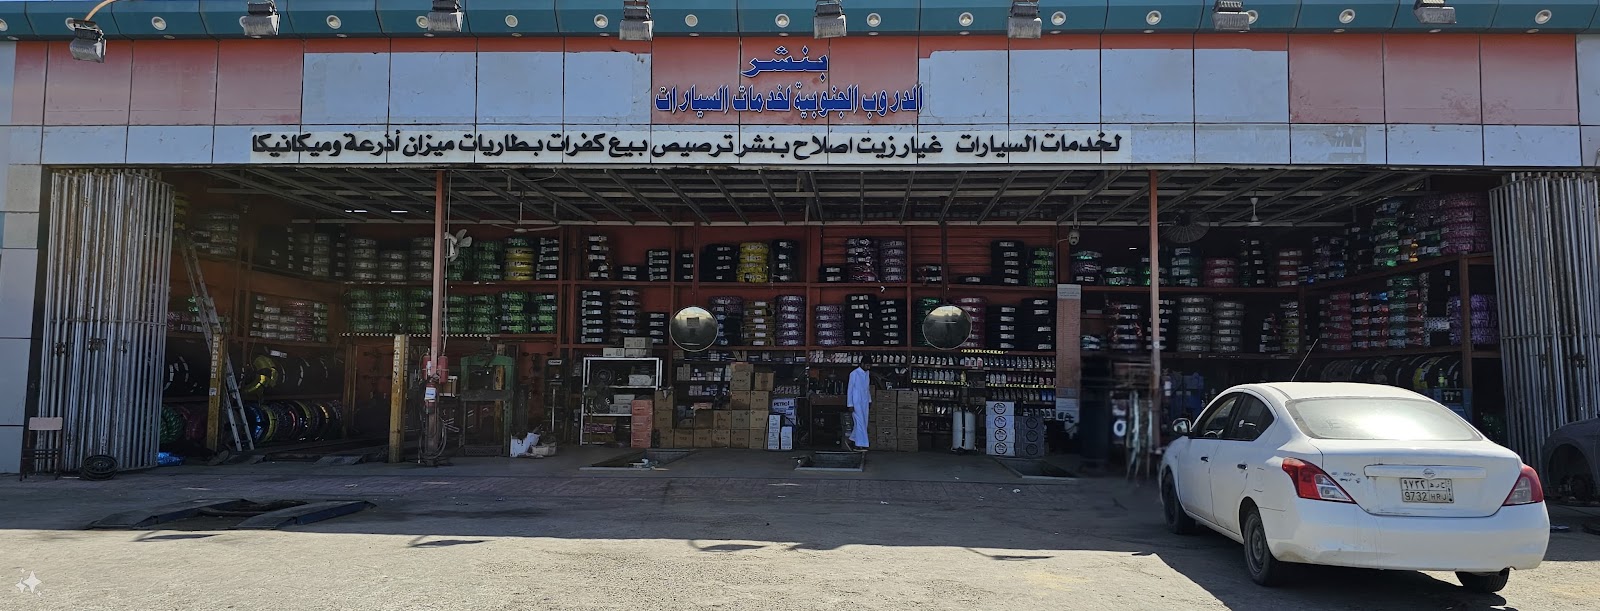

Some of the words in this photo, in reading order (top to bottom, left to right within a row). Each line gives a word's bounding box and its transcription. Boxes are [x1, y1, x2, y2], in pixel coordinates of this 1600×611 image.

[741, 45, 829, 83] بنشر
[654, 84, 730, 118] السيارات
[732, 84, 791, 113] لخدمات
[793, 82, 859, 119] الجنوبية
[861, 83, 924, 120] الدروب
[252, 133, 342, 158] وميكانيكا
[343, 129, 401, 156] أذرعة
[402, 134, 455, 157] ميزان
[458, 133, 543, 157] بطاريات
[546, 133, 606, 157] كفرات
[608, 136, 648, 157] بيع
[651, 134, 734, 158] ترصيص
[734, 134, 790, 158] بنشر
[792, 134, 853, 160] اصلاح
[857, 135, 897, 159] زيت
[896, 134, 944, 158] غيار
[956, 134, 1037, 158] السيارات
[1040, 131, 1122, 153] لخدمات
[1404, 491, 1428, 502] 9732
[1430, 493, 1447, 501] HRJ
